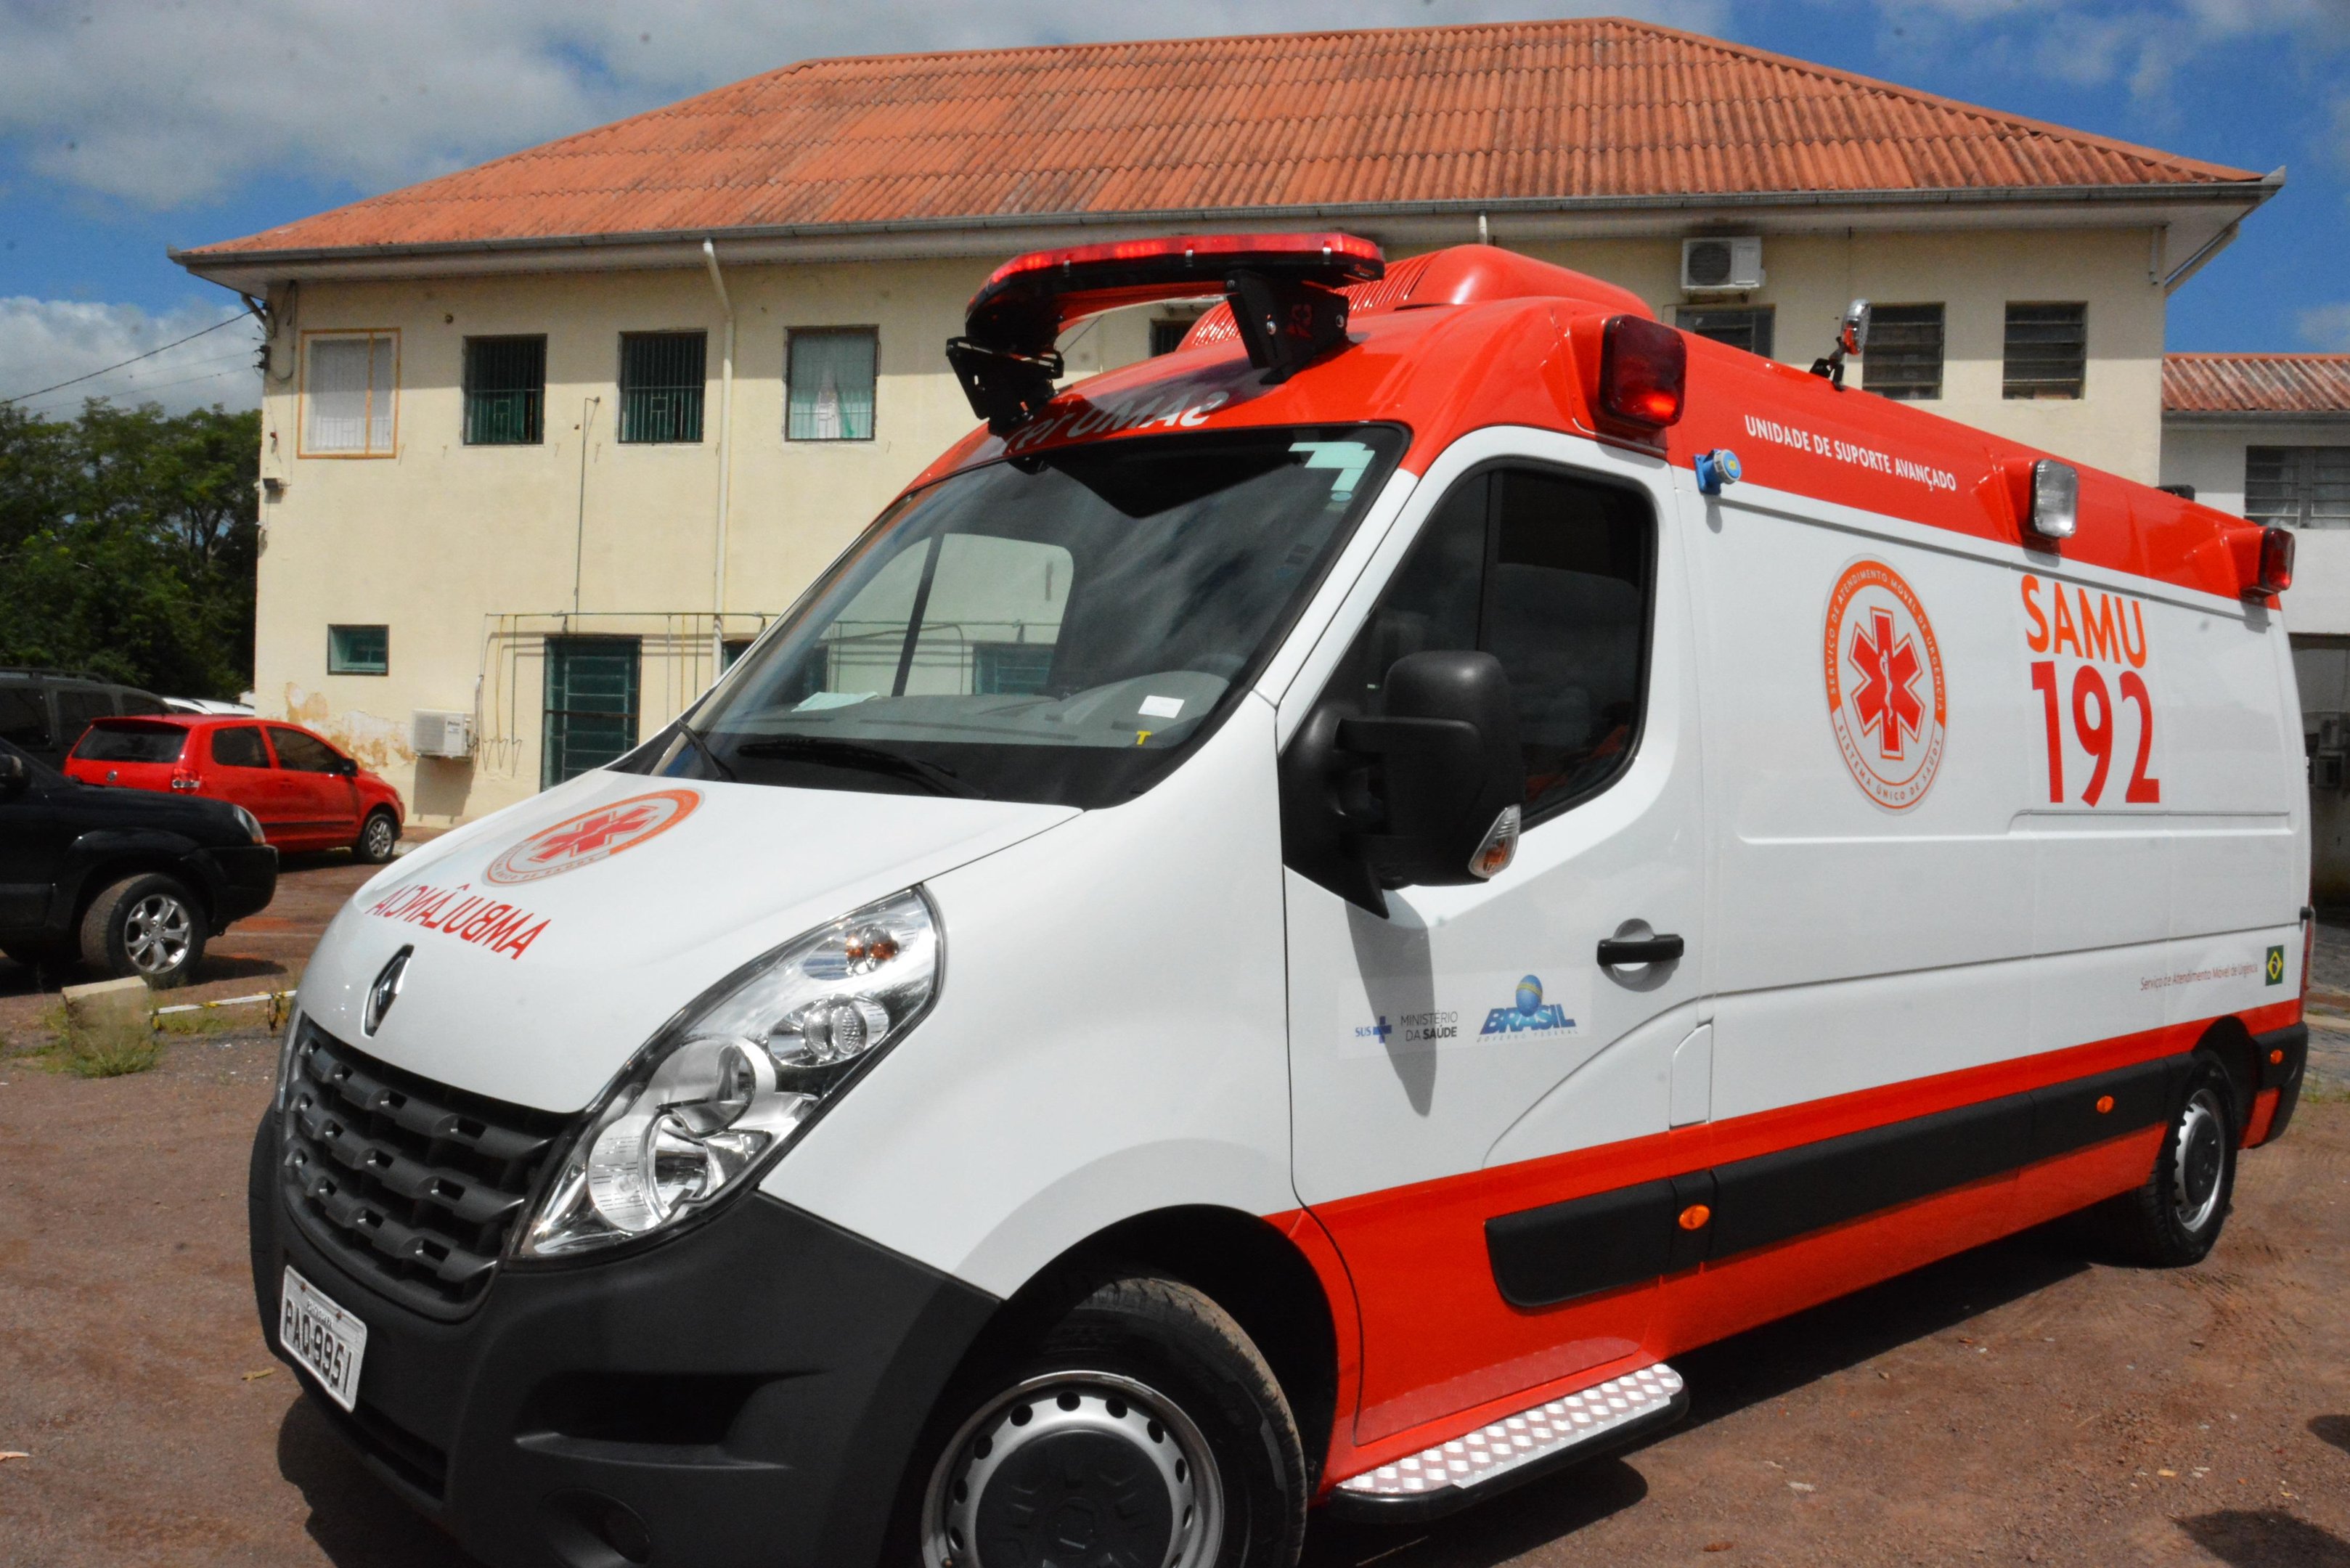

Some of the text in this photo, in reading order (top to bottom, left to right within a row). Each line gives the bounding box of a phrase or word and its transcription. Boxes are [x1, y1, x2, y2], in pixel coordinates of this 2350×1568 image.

[1745, 415, 1957, 491] UNIDADE DE SUPORTE AVANÇADO
[1827, 628, 1837, 695] SERVIÇO
[1832, 605, 1840, 624] DE
[1837, 569, 1888, 605] ATENDIMENTO
[1917, 614, 1927, 632] DE
[2021, 574, 2147, 669] SAMU
[1136, 730, 1152, 746] T
[2031, 661, 2160, 808] 192
[1838, 724, 1872, 787] SISTEMA
[1876, 784, 1906, 801] ÚNICO
[1909, 783, 1920, 796] DE
[1355, 1026, 1371, 1037] SUS
[1400, 1010, 1458, 1026] MINISTÉRIO
[1405, 1024, 1457, 1041] DA SAÚDE
[1480, 1004, 1576, 1034] BRASIL
